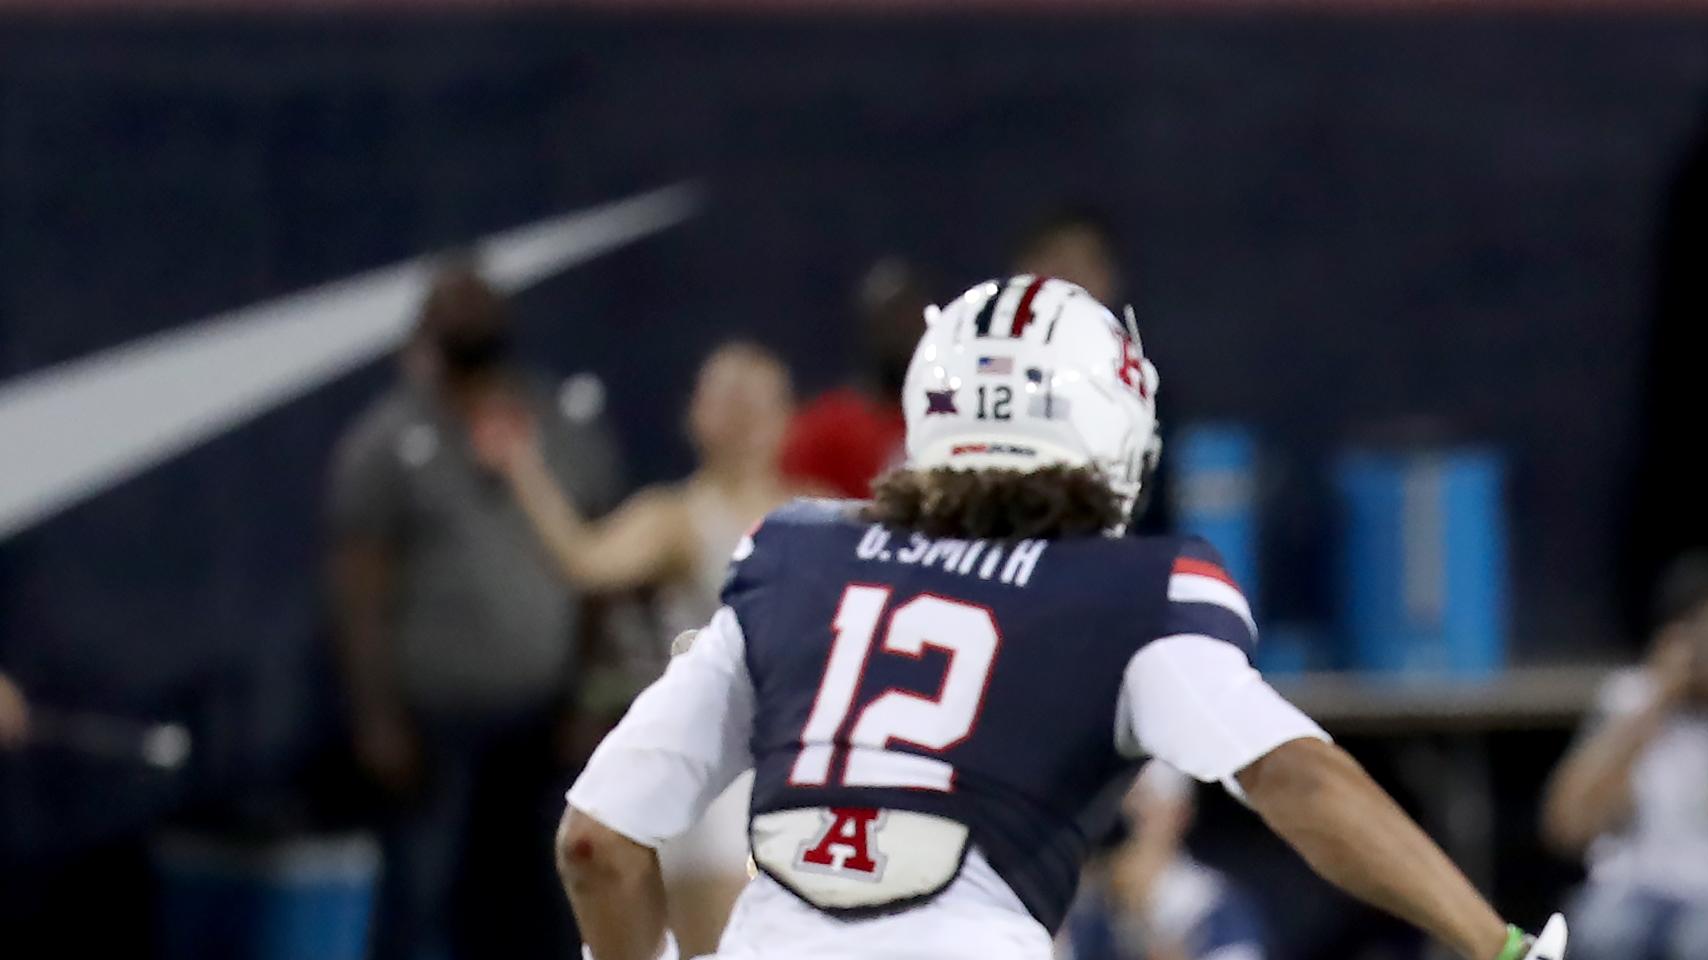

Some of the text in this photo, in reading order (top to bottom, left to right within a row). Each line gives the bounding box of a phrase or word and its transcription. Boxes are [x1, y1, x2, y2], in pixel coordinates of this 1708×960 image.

[977, 386, 1012, 419] 12
[786, 582, 1002, 793] 12
[797, 806, 884, 878] A
